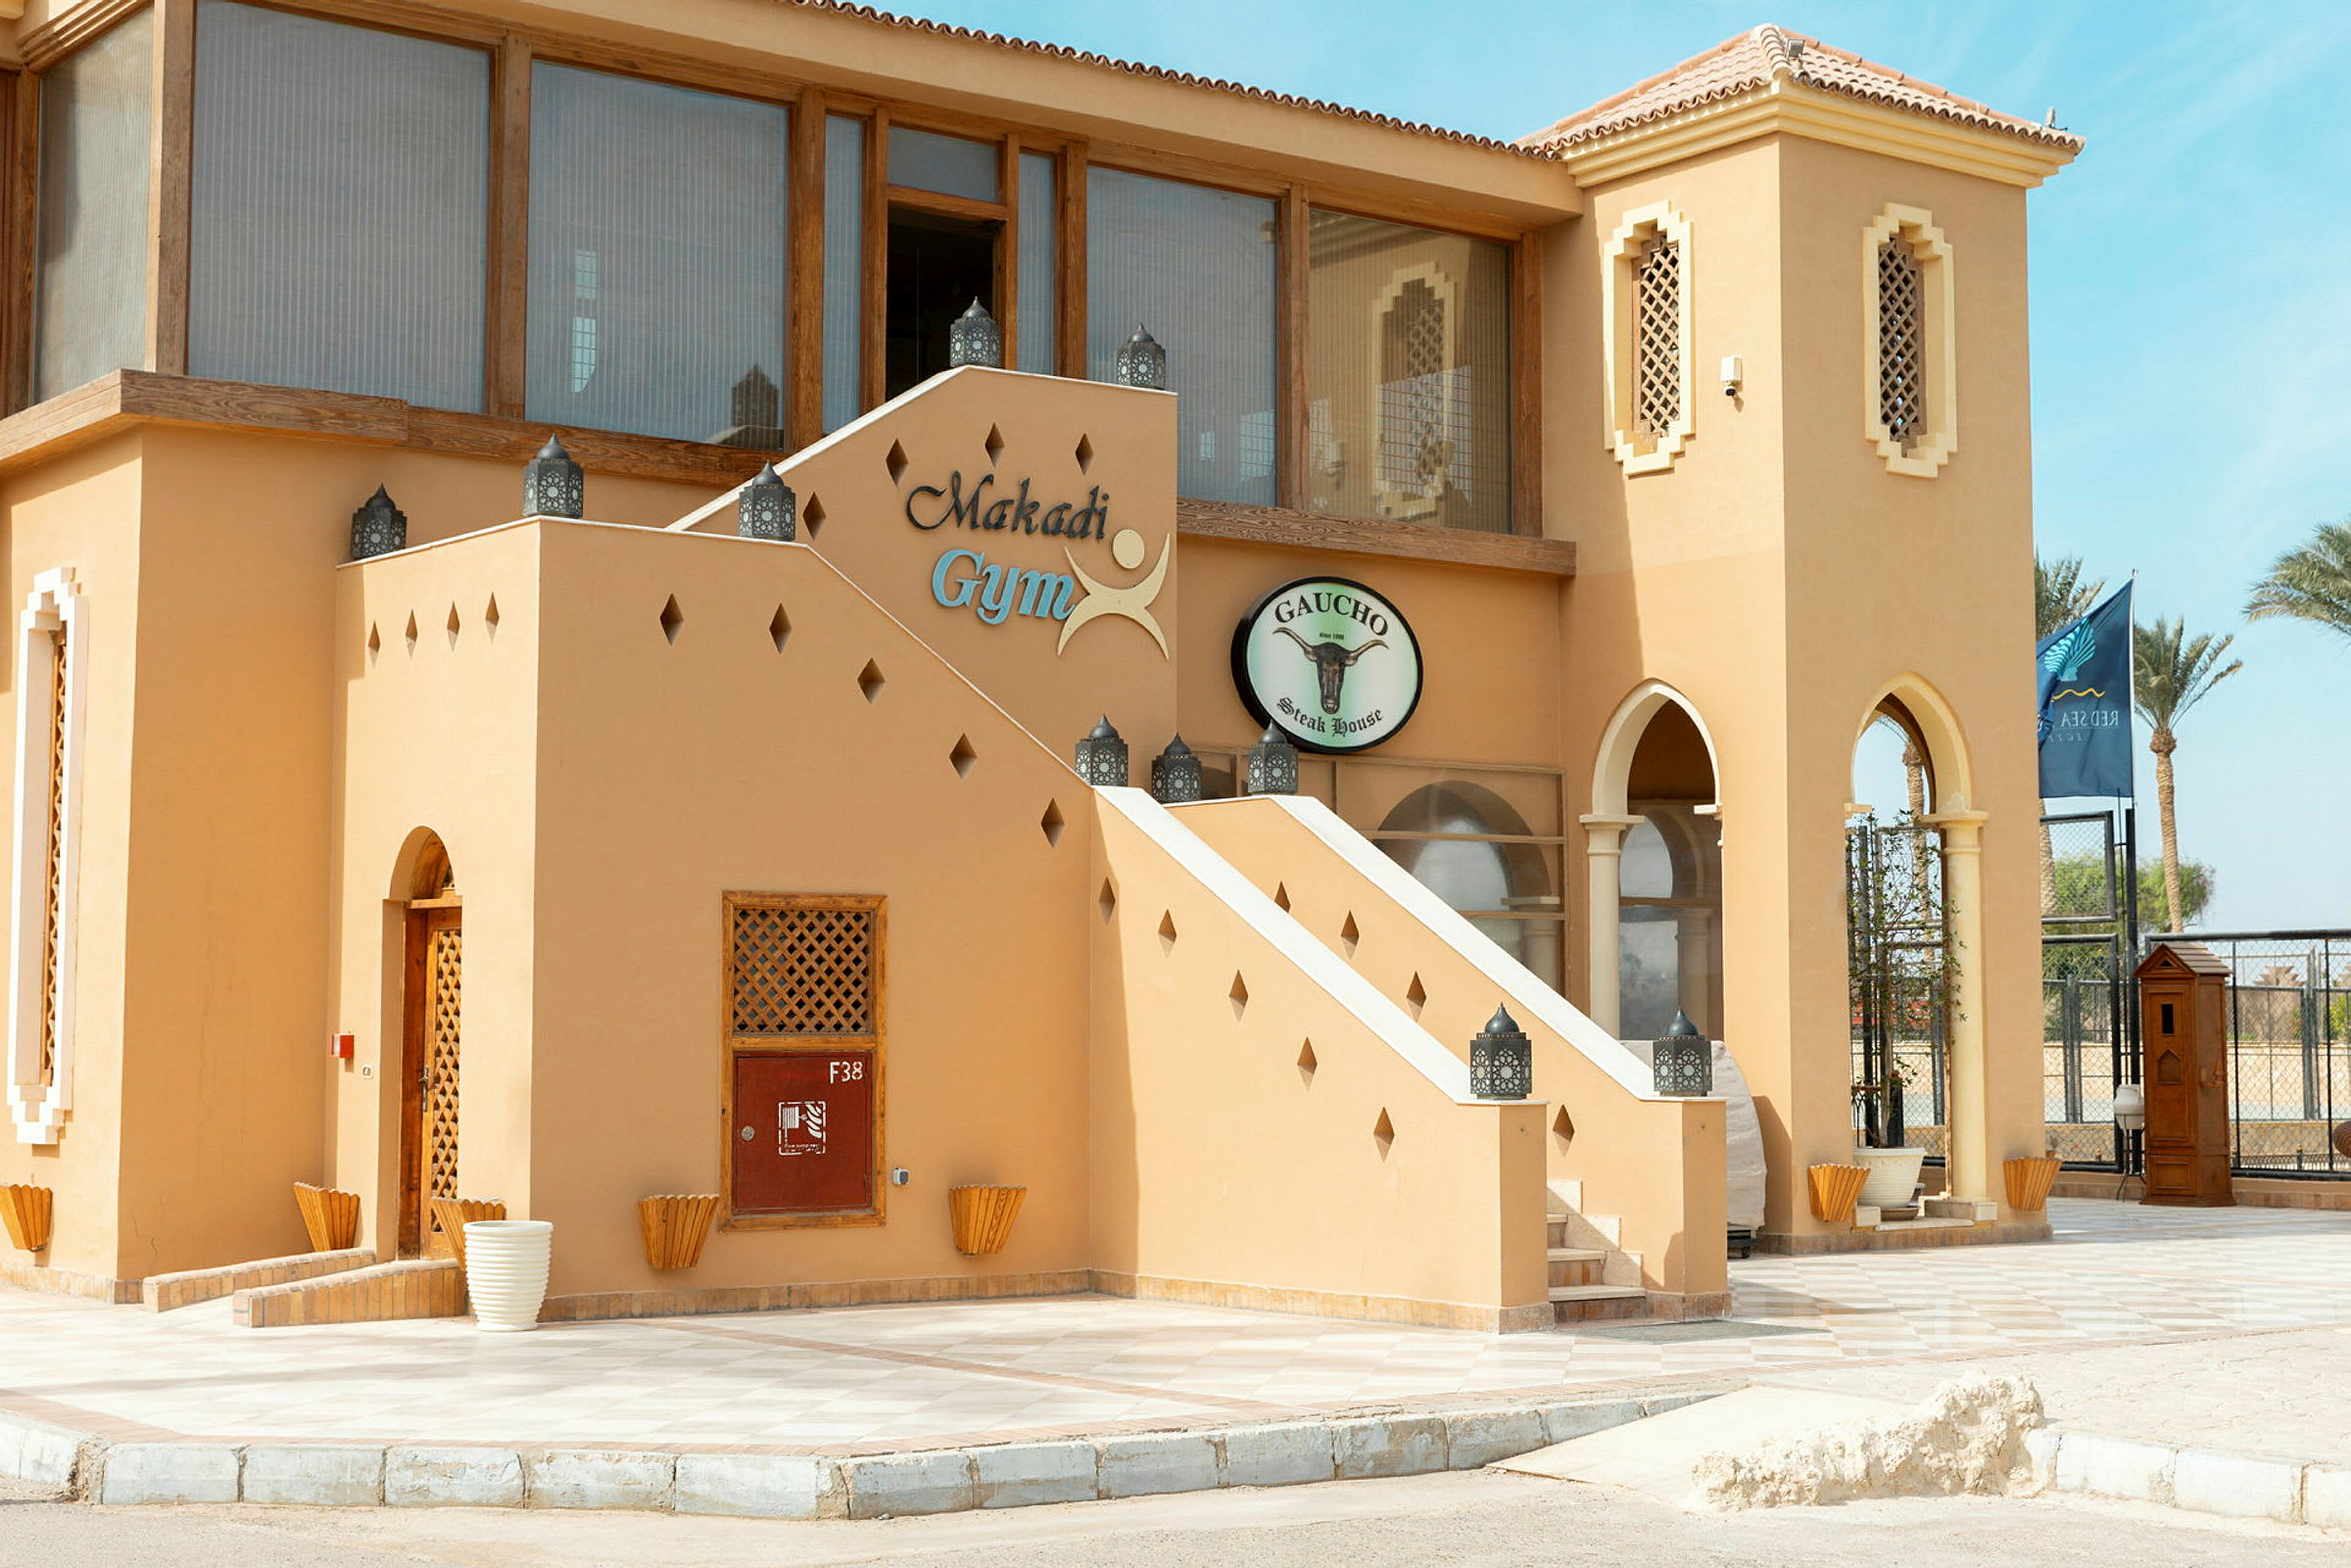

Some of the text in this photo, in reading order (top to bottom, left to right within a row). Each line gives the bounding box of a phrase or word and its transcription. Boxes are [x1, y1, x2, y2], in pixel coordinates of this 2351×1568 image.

[906, 470, 1110, 543] Makadi
[932, 548, 1078, 625] Gym
[1274, 593, 1389, 637] GAUCHO
[1276, 696, 1383, 737] Steak House
[830, 1061, 863, 1084] F38
